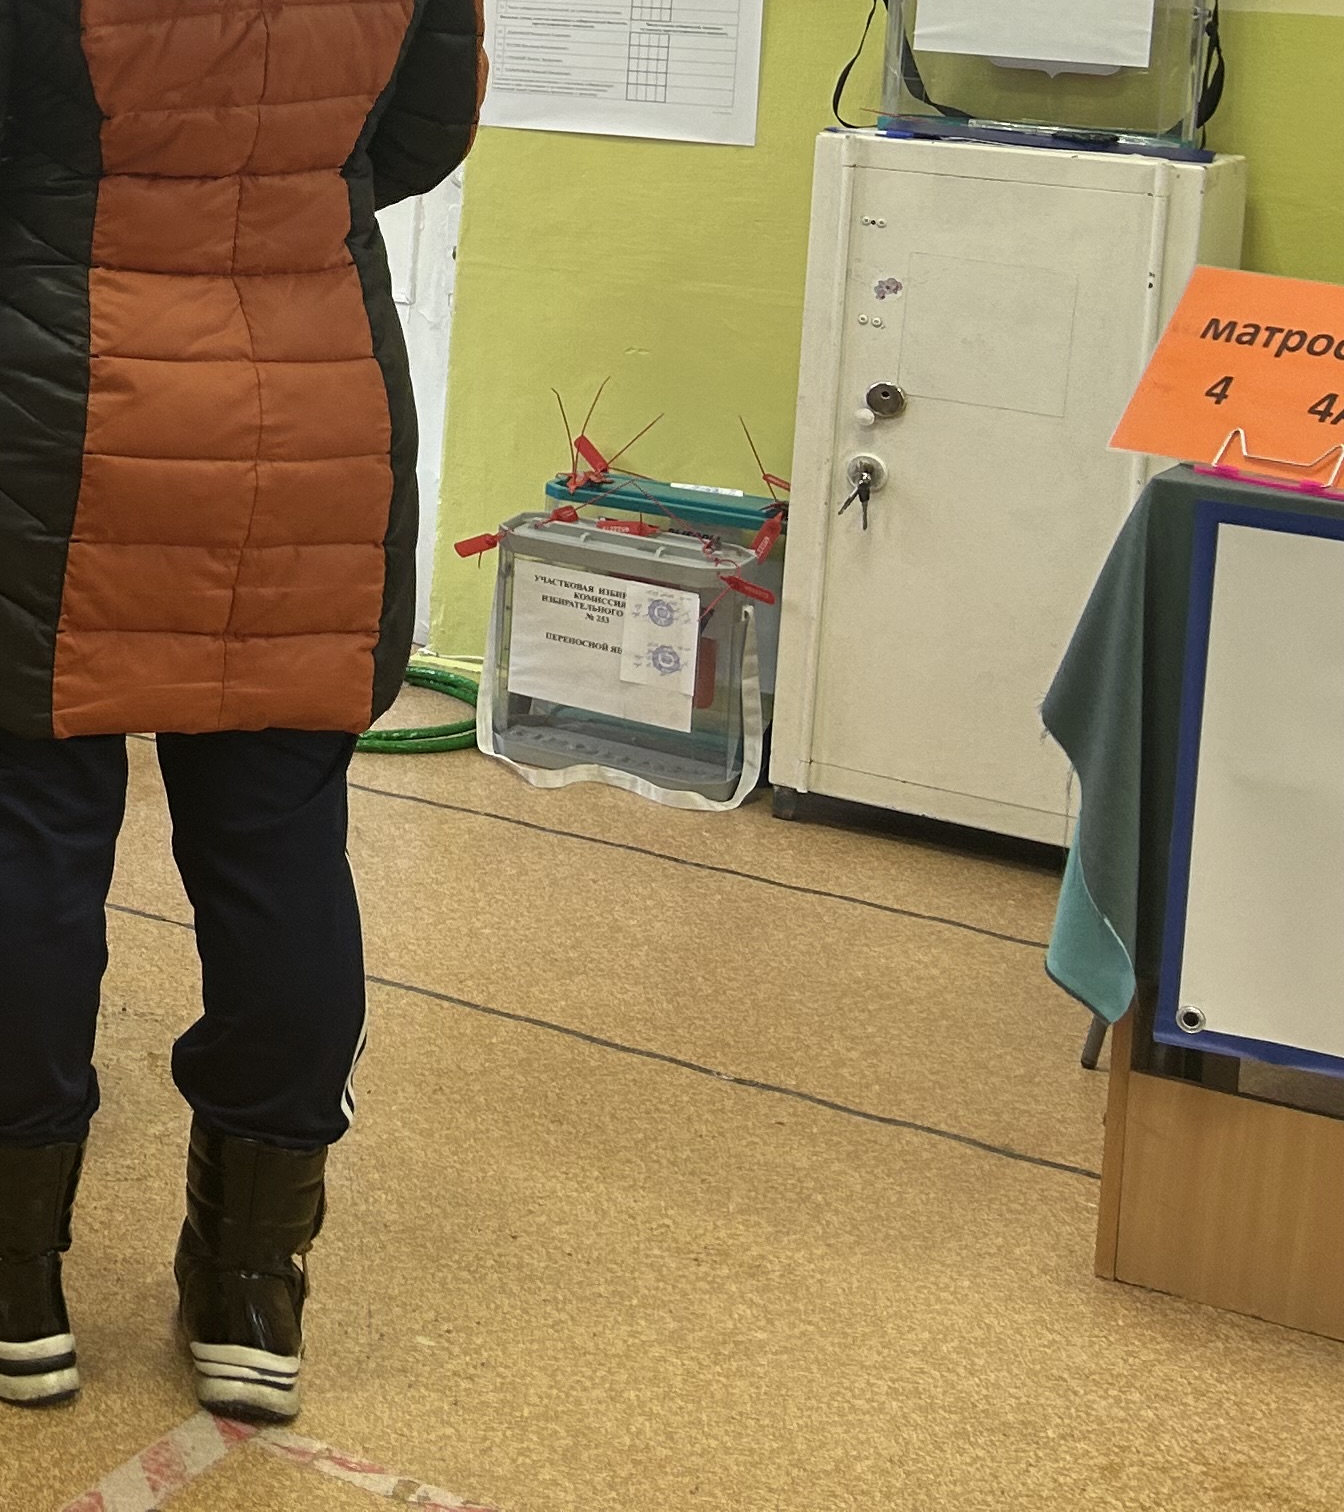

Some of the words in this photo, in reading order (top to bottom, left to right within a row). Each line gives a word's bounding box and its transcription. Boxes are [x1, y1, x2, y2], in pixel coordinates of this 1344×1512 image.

[1204, 375, 1234, 405] 4
[534, 574, 594, 593] УЧАСТКОВАЯ
[541, 594, 624, 617] ИЗБИРАТЕЛЬНОГО
[573, 591, 626, 608] КОМИССИЯ
[545, 631, 609, 652] ПЕРЕНОСНОЙ
